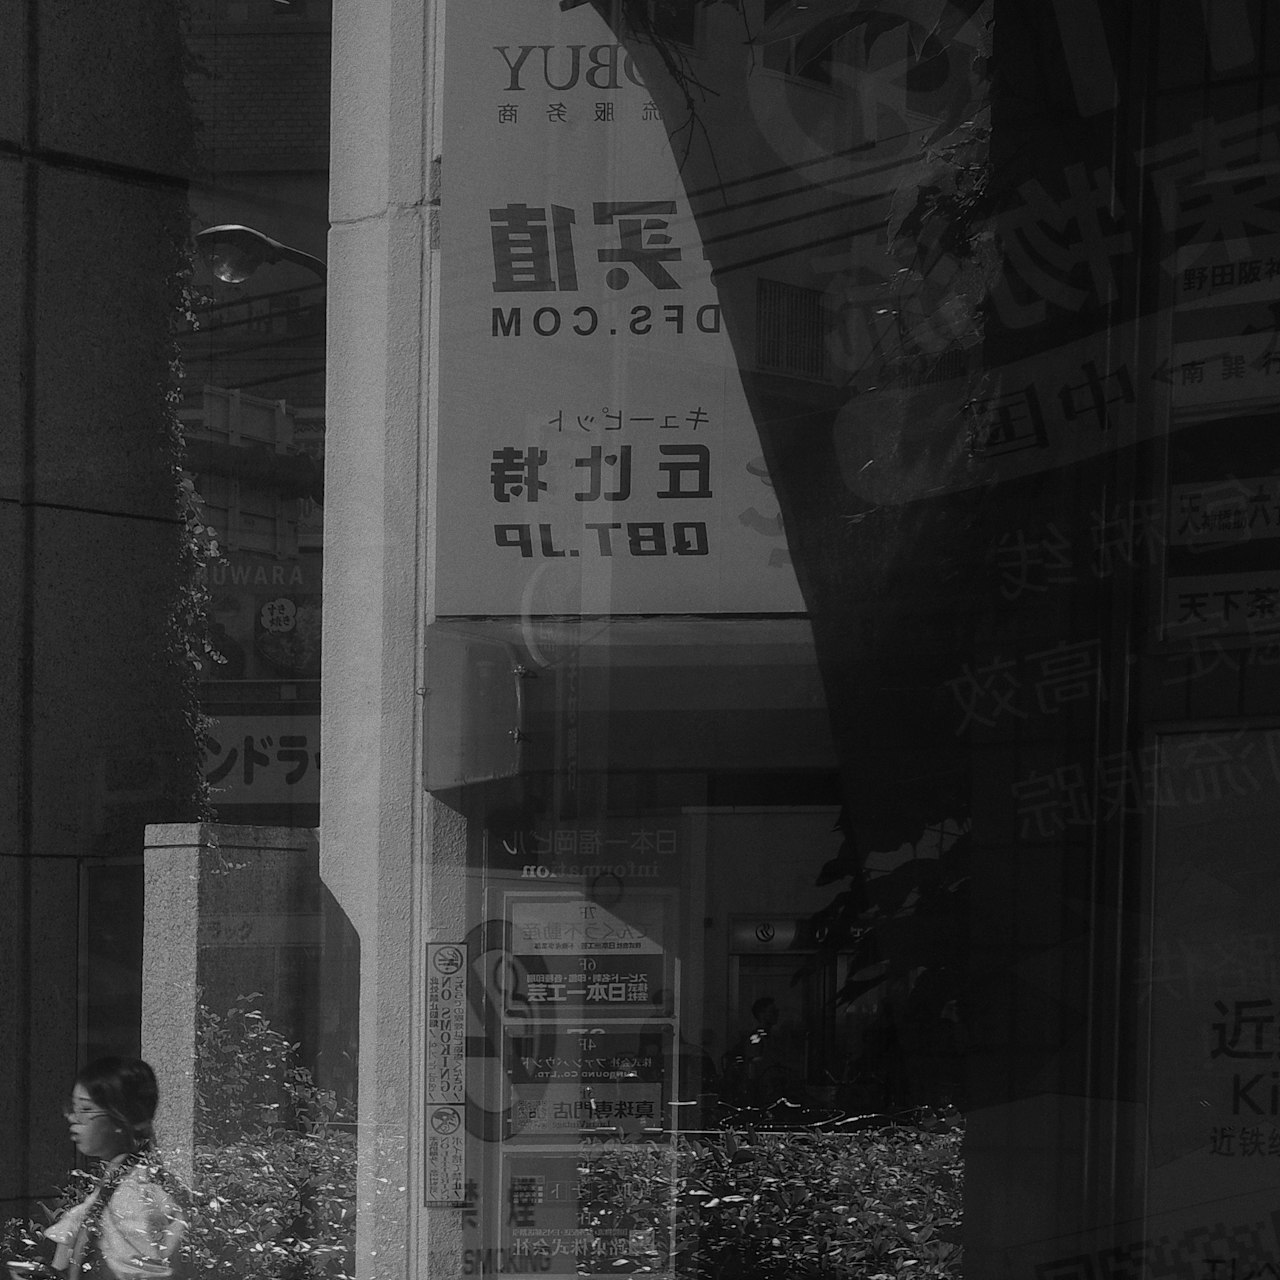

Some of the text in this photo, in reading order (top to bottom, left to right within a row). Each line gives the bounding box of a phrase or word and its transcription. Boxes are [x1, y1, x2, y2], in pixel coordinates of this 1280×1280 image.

[204, 735, 321, 785] ンドラ
[1210, 998, 1280, 1059] 近
